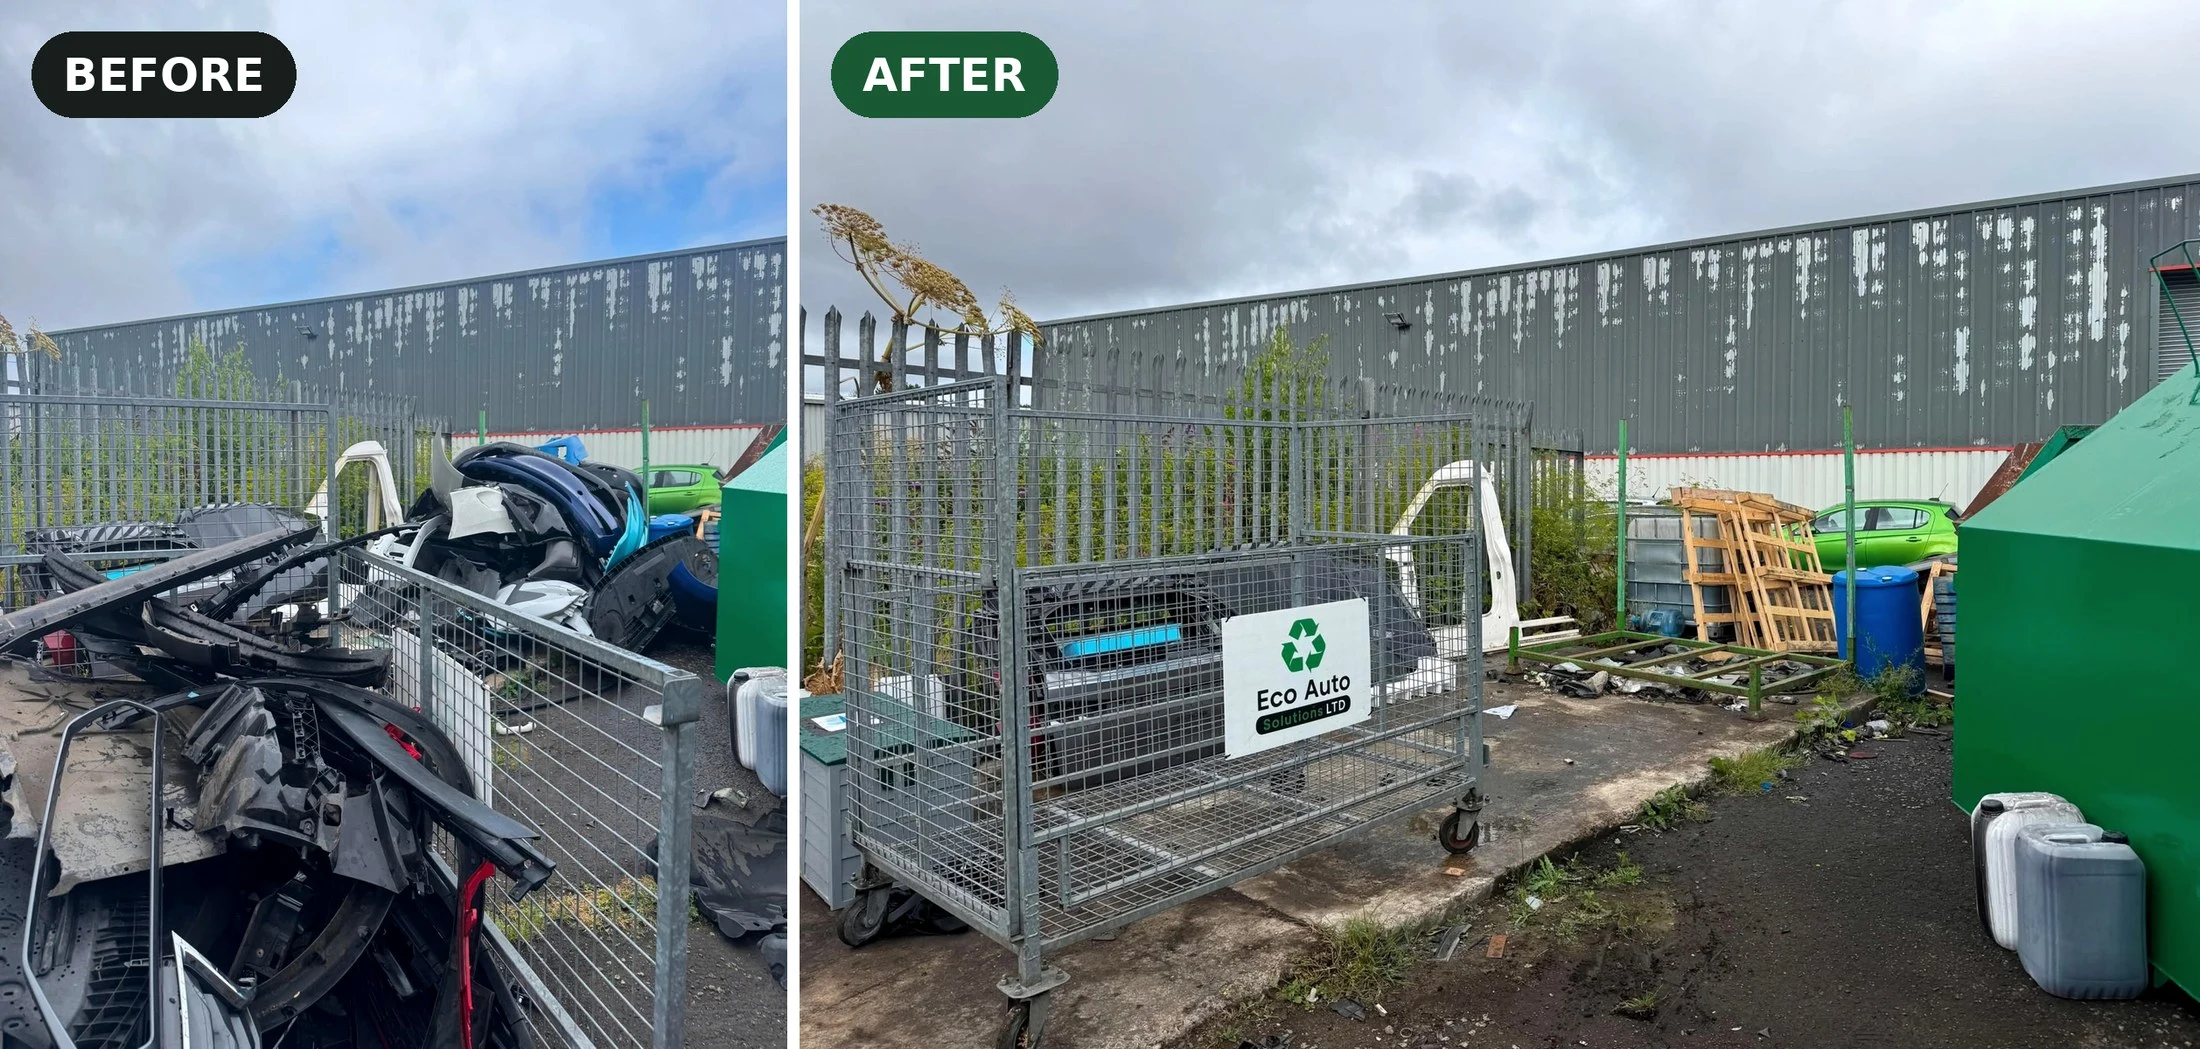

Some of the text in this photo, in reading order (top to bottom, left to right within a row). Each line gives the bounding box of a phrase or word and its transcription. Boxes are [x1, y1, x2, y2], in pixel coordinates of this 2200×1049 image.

[1257, 675, 1351, 711] Eco Auto
[1263, 699, 1346, 731] Solutions LTD
